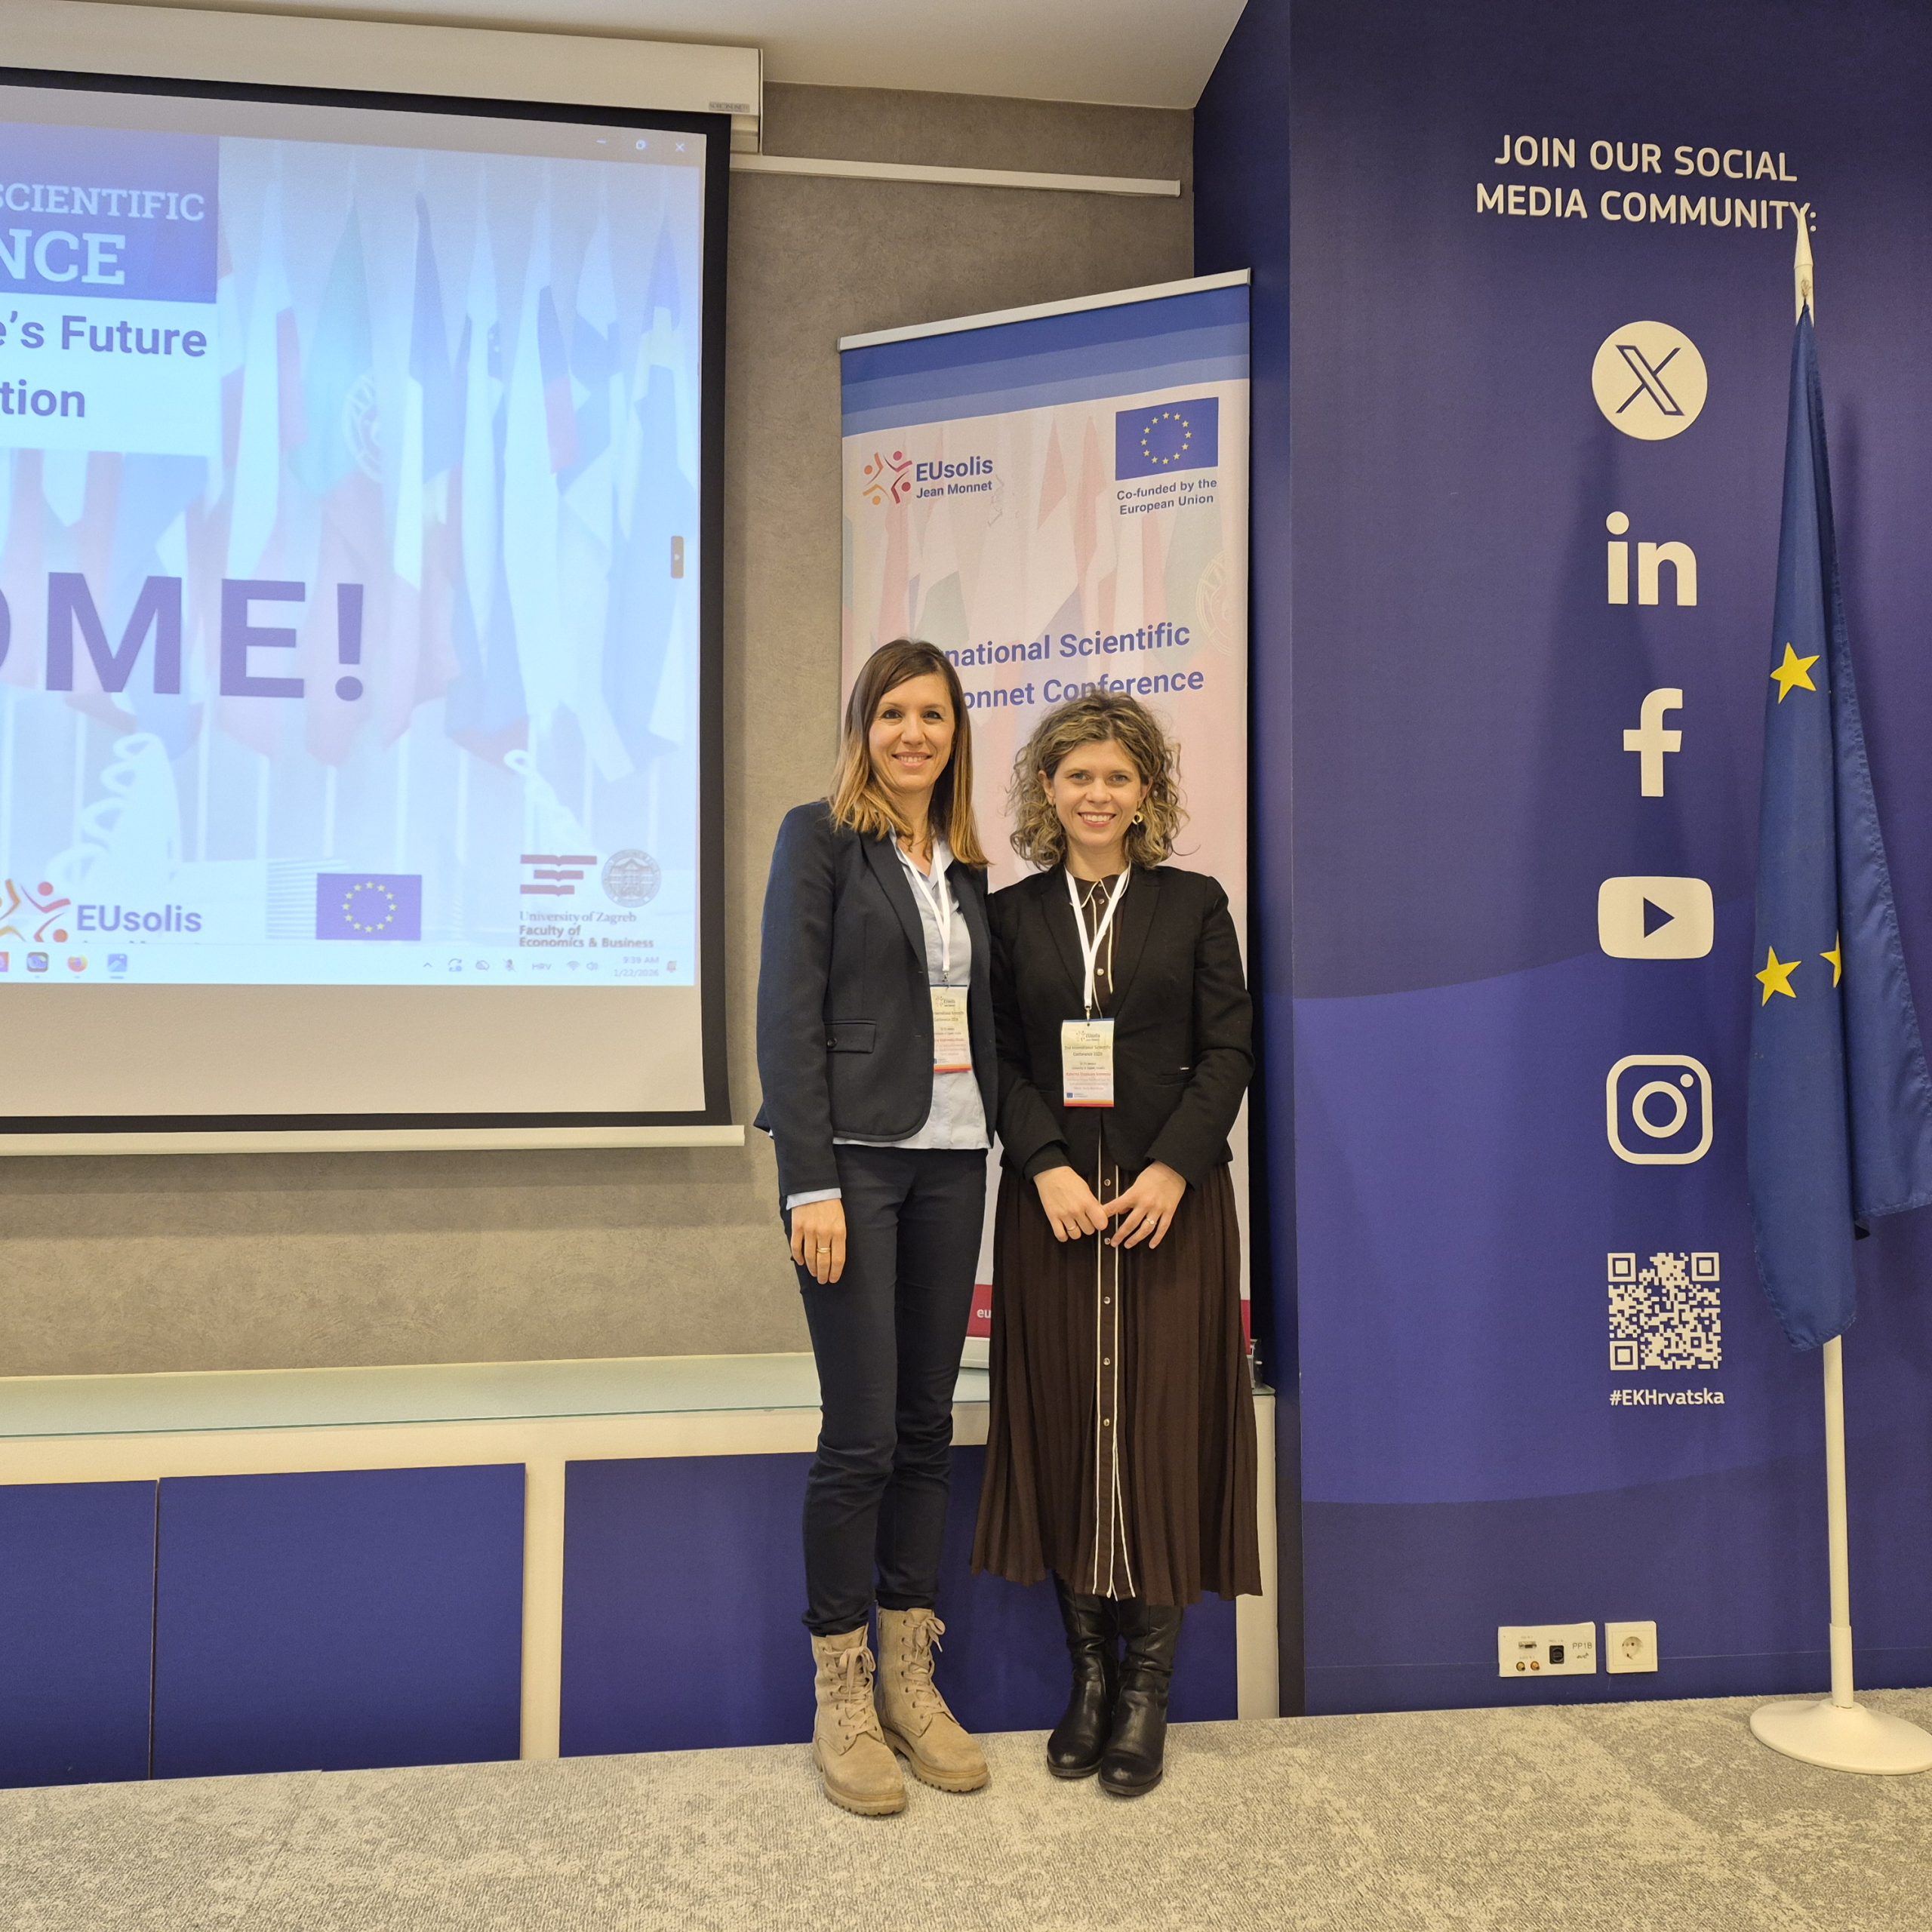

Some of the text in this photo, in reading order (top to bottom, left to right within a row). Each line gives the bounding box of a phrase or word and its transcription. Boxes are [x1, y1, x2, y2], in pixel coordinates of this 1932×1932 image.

[1494, 134, 1798, 182] JOIN OUR SOCIAL
[0, 183, 205, 221] CIENTIFIC
[1475, 183, 1817, 232] MEDIA COMMUNITY:
[0, 310, 207, 357] ’s Future
[916, 456, 993, 481] EUsolis
[916, 481, 992, 499] Jean Monnet
[1117, 478, 1217, 500] Co-funded by the
[1120, 494, 1214, 515] European Union
[1606, 511, 1697, 606] in
[0, 571, 364, 702] ME!
[945, 622, 1190, 668] national Scientific
[963, 682, 1035, 709] onnet
[1623, 688, 1683, 797] f
[77, 905, 202, 932] EUsolis
[519, 911, 637, 924] University of Zagreb
[519, 924, 581, 937] Faculty of
[518, 937, 654, 948] Economics & Business
[1610, 1388, 1724, 1405] #EKHrvatska
